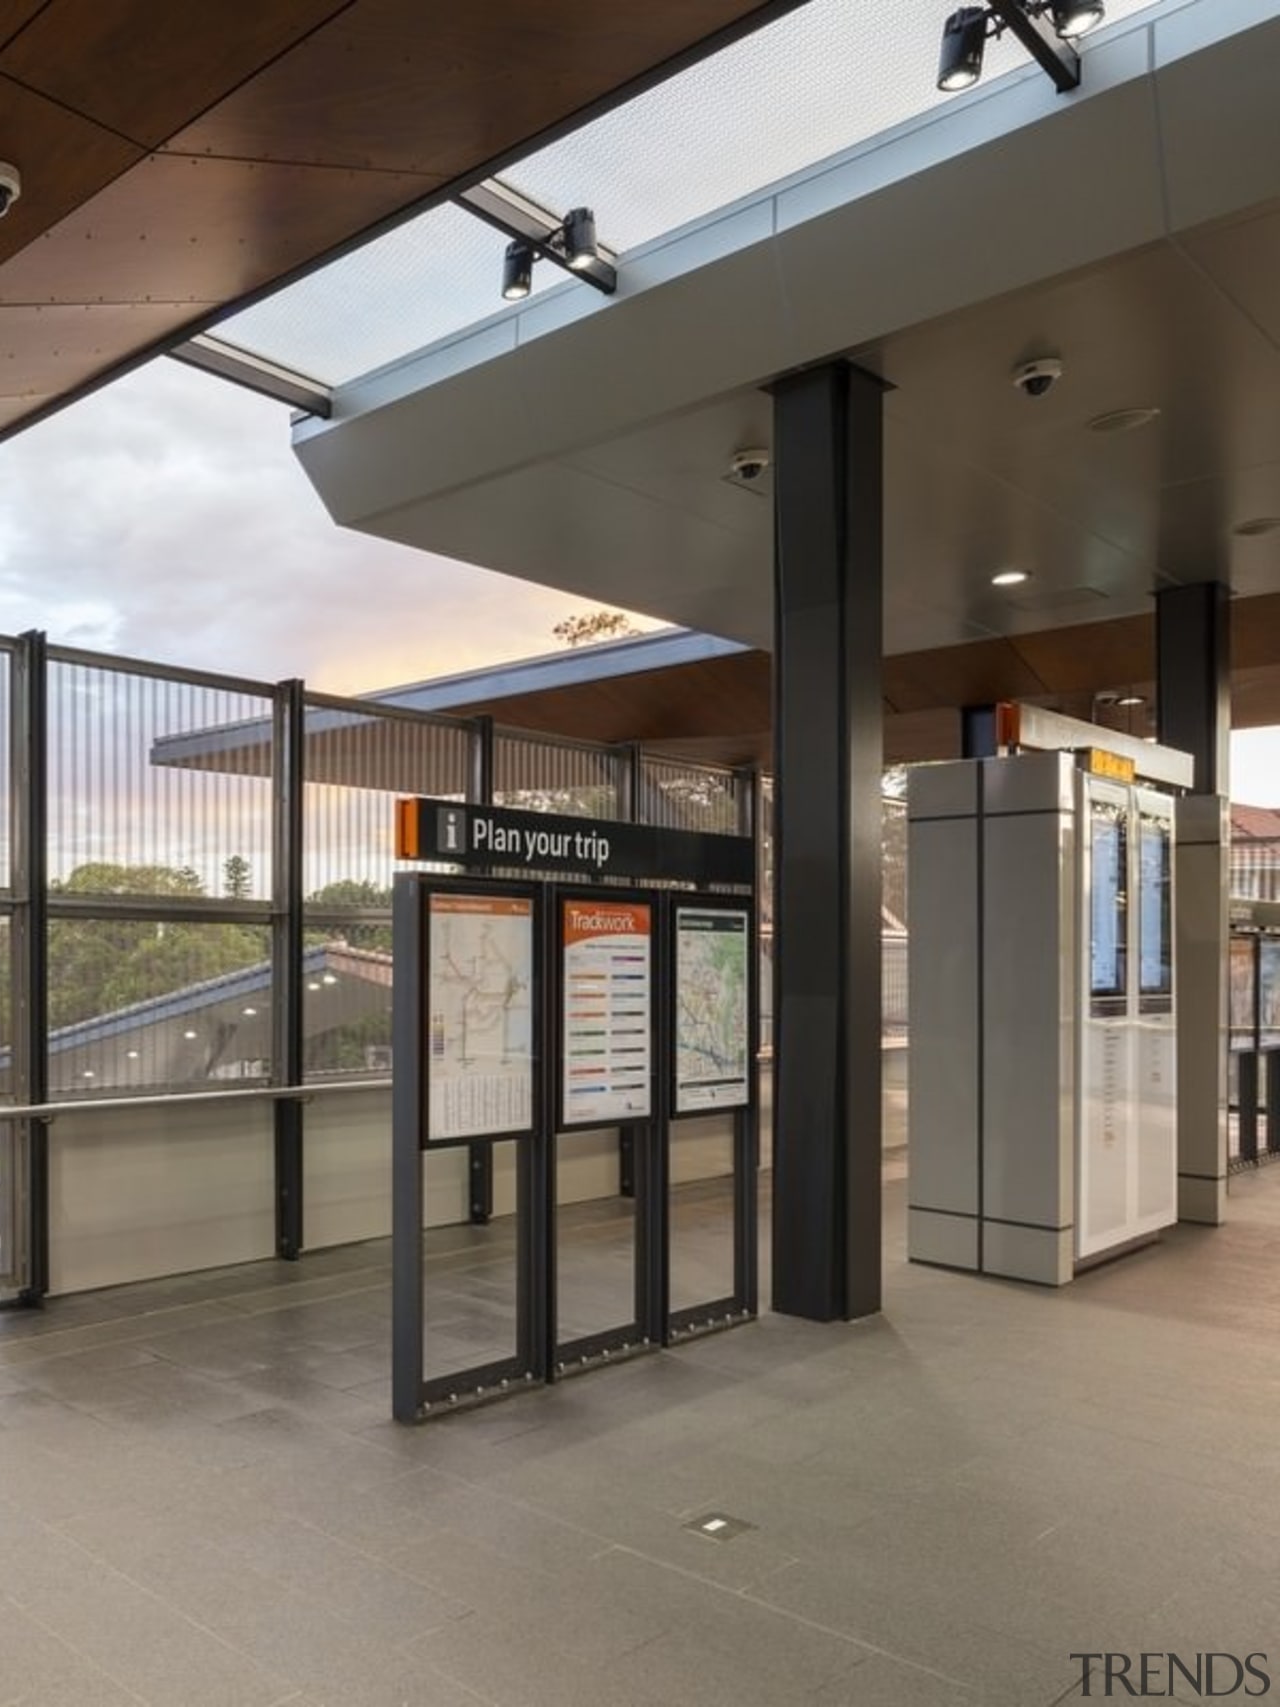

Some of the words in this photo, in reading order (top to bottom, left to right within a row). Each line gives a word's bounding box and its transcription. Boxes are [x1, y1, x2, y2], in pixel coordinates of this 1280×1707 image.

[473, 818, 520, 853] Plan
[525, 830, 572, 861] your
[575, 829, 610, 868] trip
[570, 910, 634, 931] Trackwork
